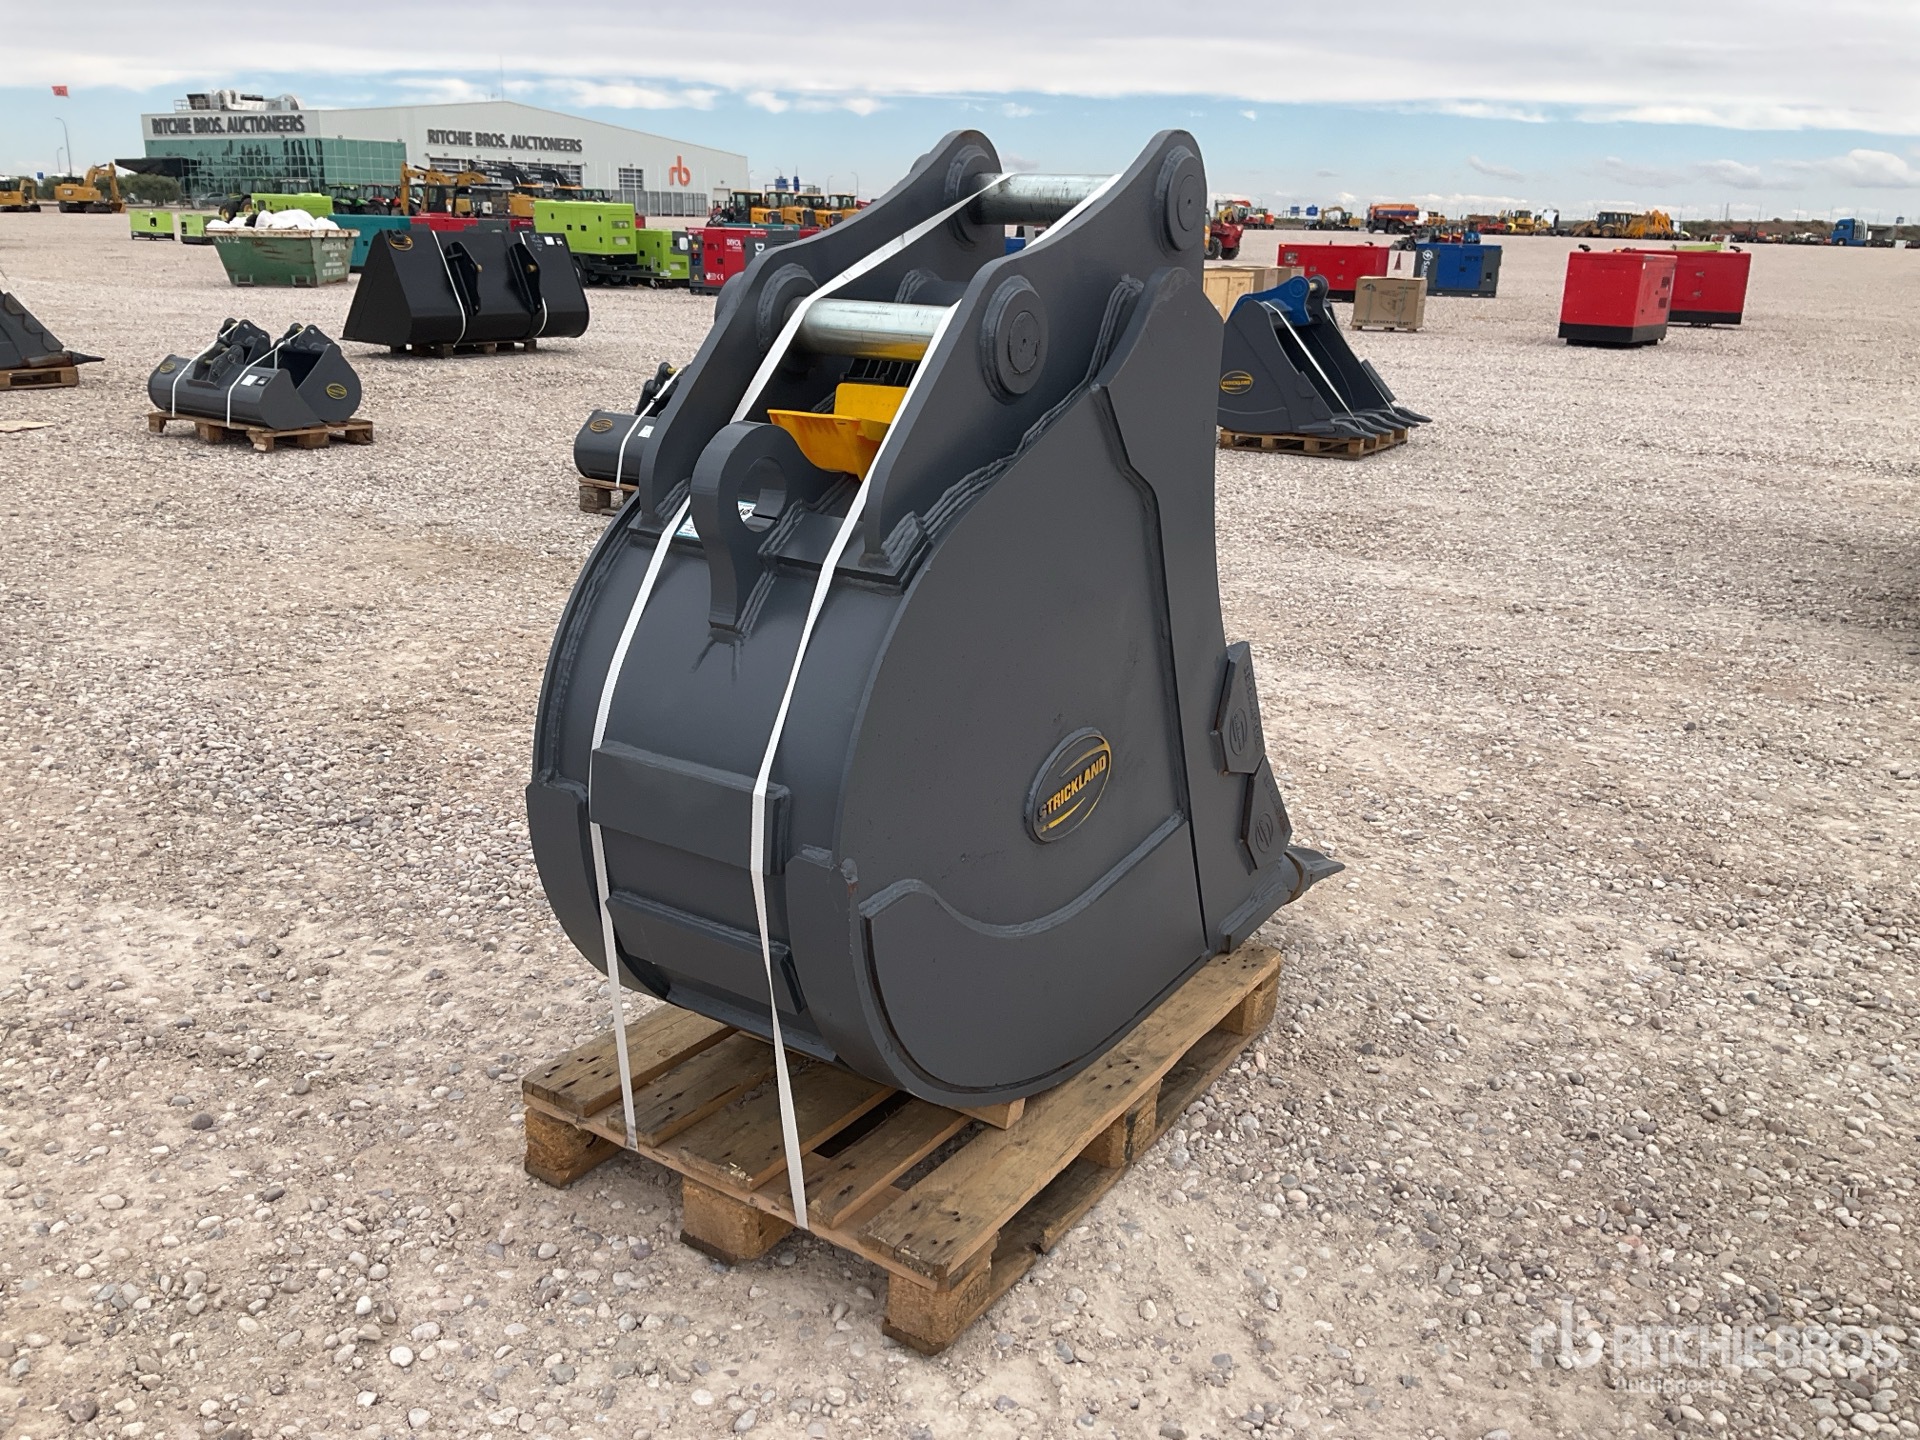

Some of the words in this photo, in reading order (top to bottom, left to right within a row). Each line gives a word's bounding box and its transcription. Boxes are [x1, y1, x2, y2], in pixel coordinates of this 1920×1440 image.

[151, 117, 192, 134] RITCHIE
[193, 116, 226, 134] BROS.
[227, 114, 305, 133] AUCTIONEERS
[427, 129, 473, 146] RITCHIE
[475, 132, 508, 149] BROS.
[510, 134, 583, 152] AUCTIONEERS
[669, 155, 691, 187] rb
[1038, 754, 1106, 821] STRICKLAND
